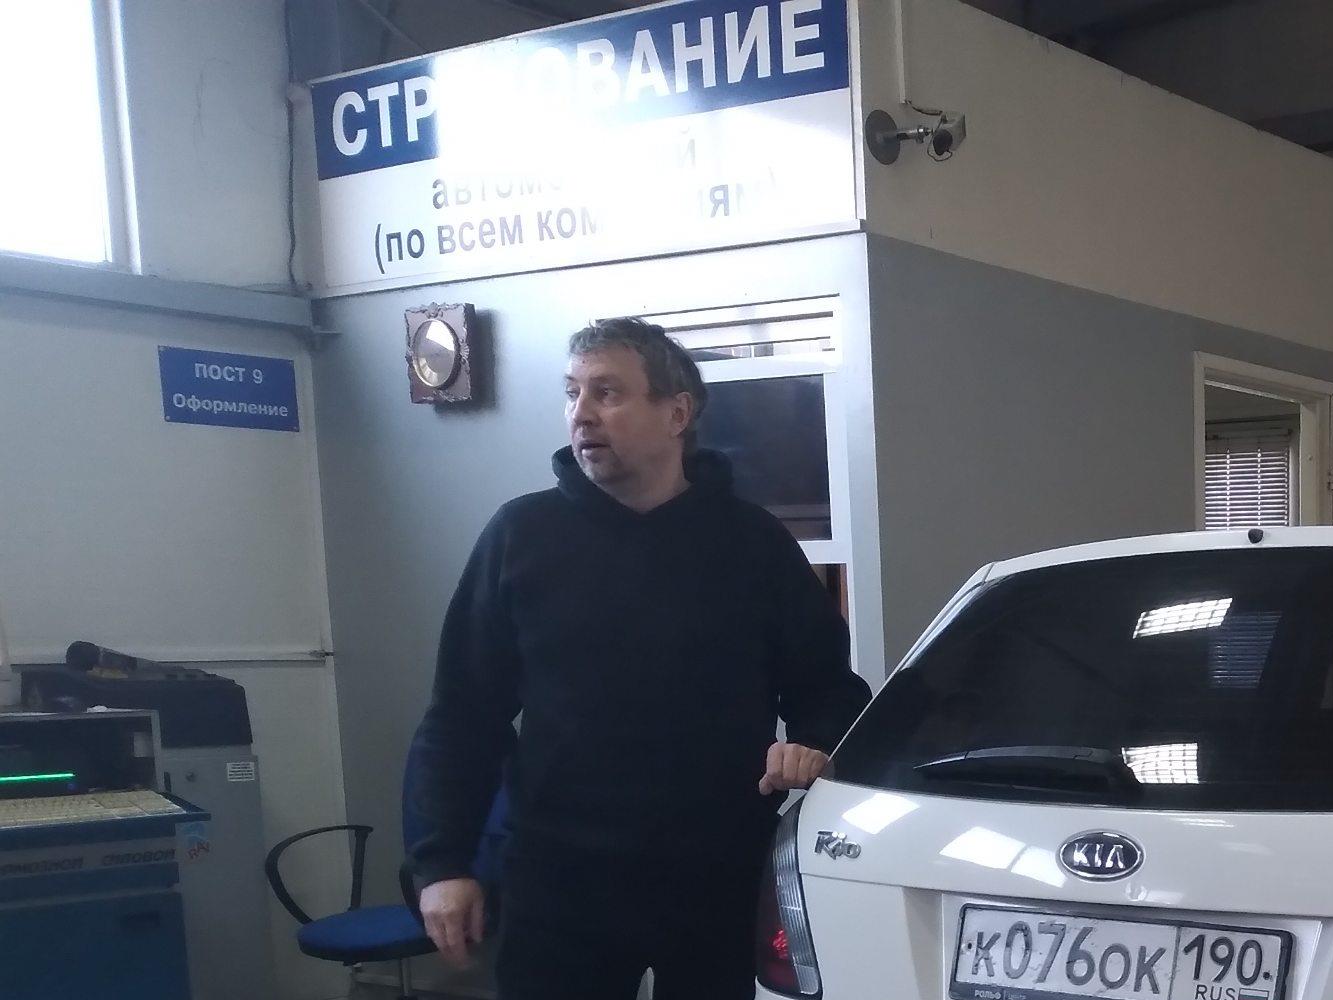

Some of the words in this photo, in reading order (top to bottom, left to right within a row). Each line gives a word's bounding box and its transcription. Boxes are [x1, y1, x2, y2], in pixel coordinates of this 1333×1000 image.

[332, 1, 826, 157] СТРОВАНИЕ
[374, 222, 426, 275] (по
[437, 213, 524, 256] всем
[194, 362, 246, 383] ПОСТ
[252, 368, 264, 385] 9
[172, 392, 289, 417] Оформление
[1072, 842, 1127, 870] KIA
[1182, 934, 1263, 986] 190
